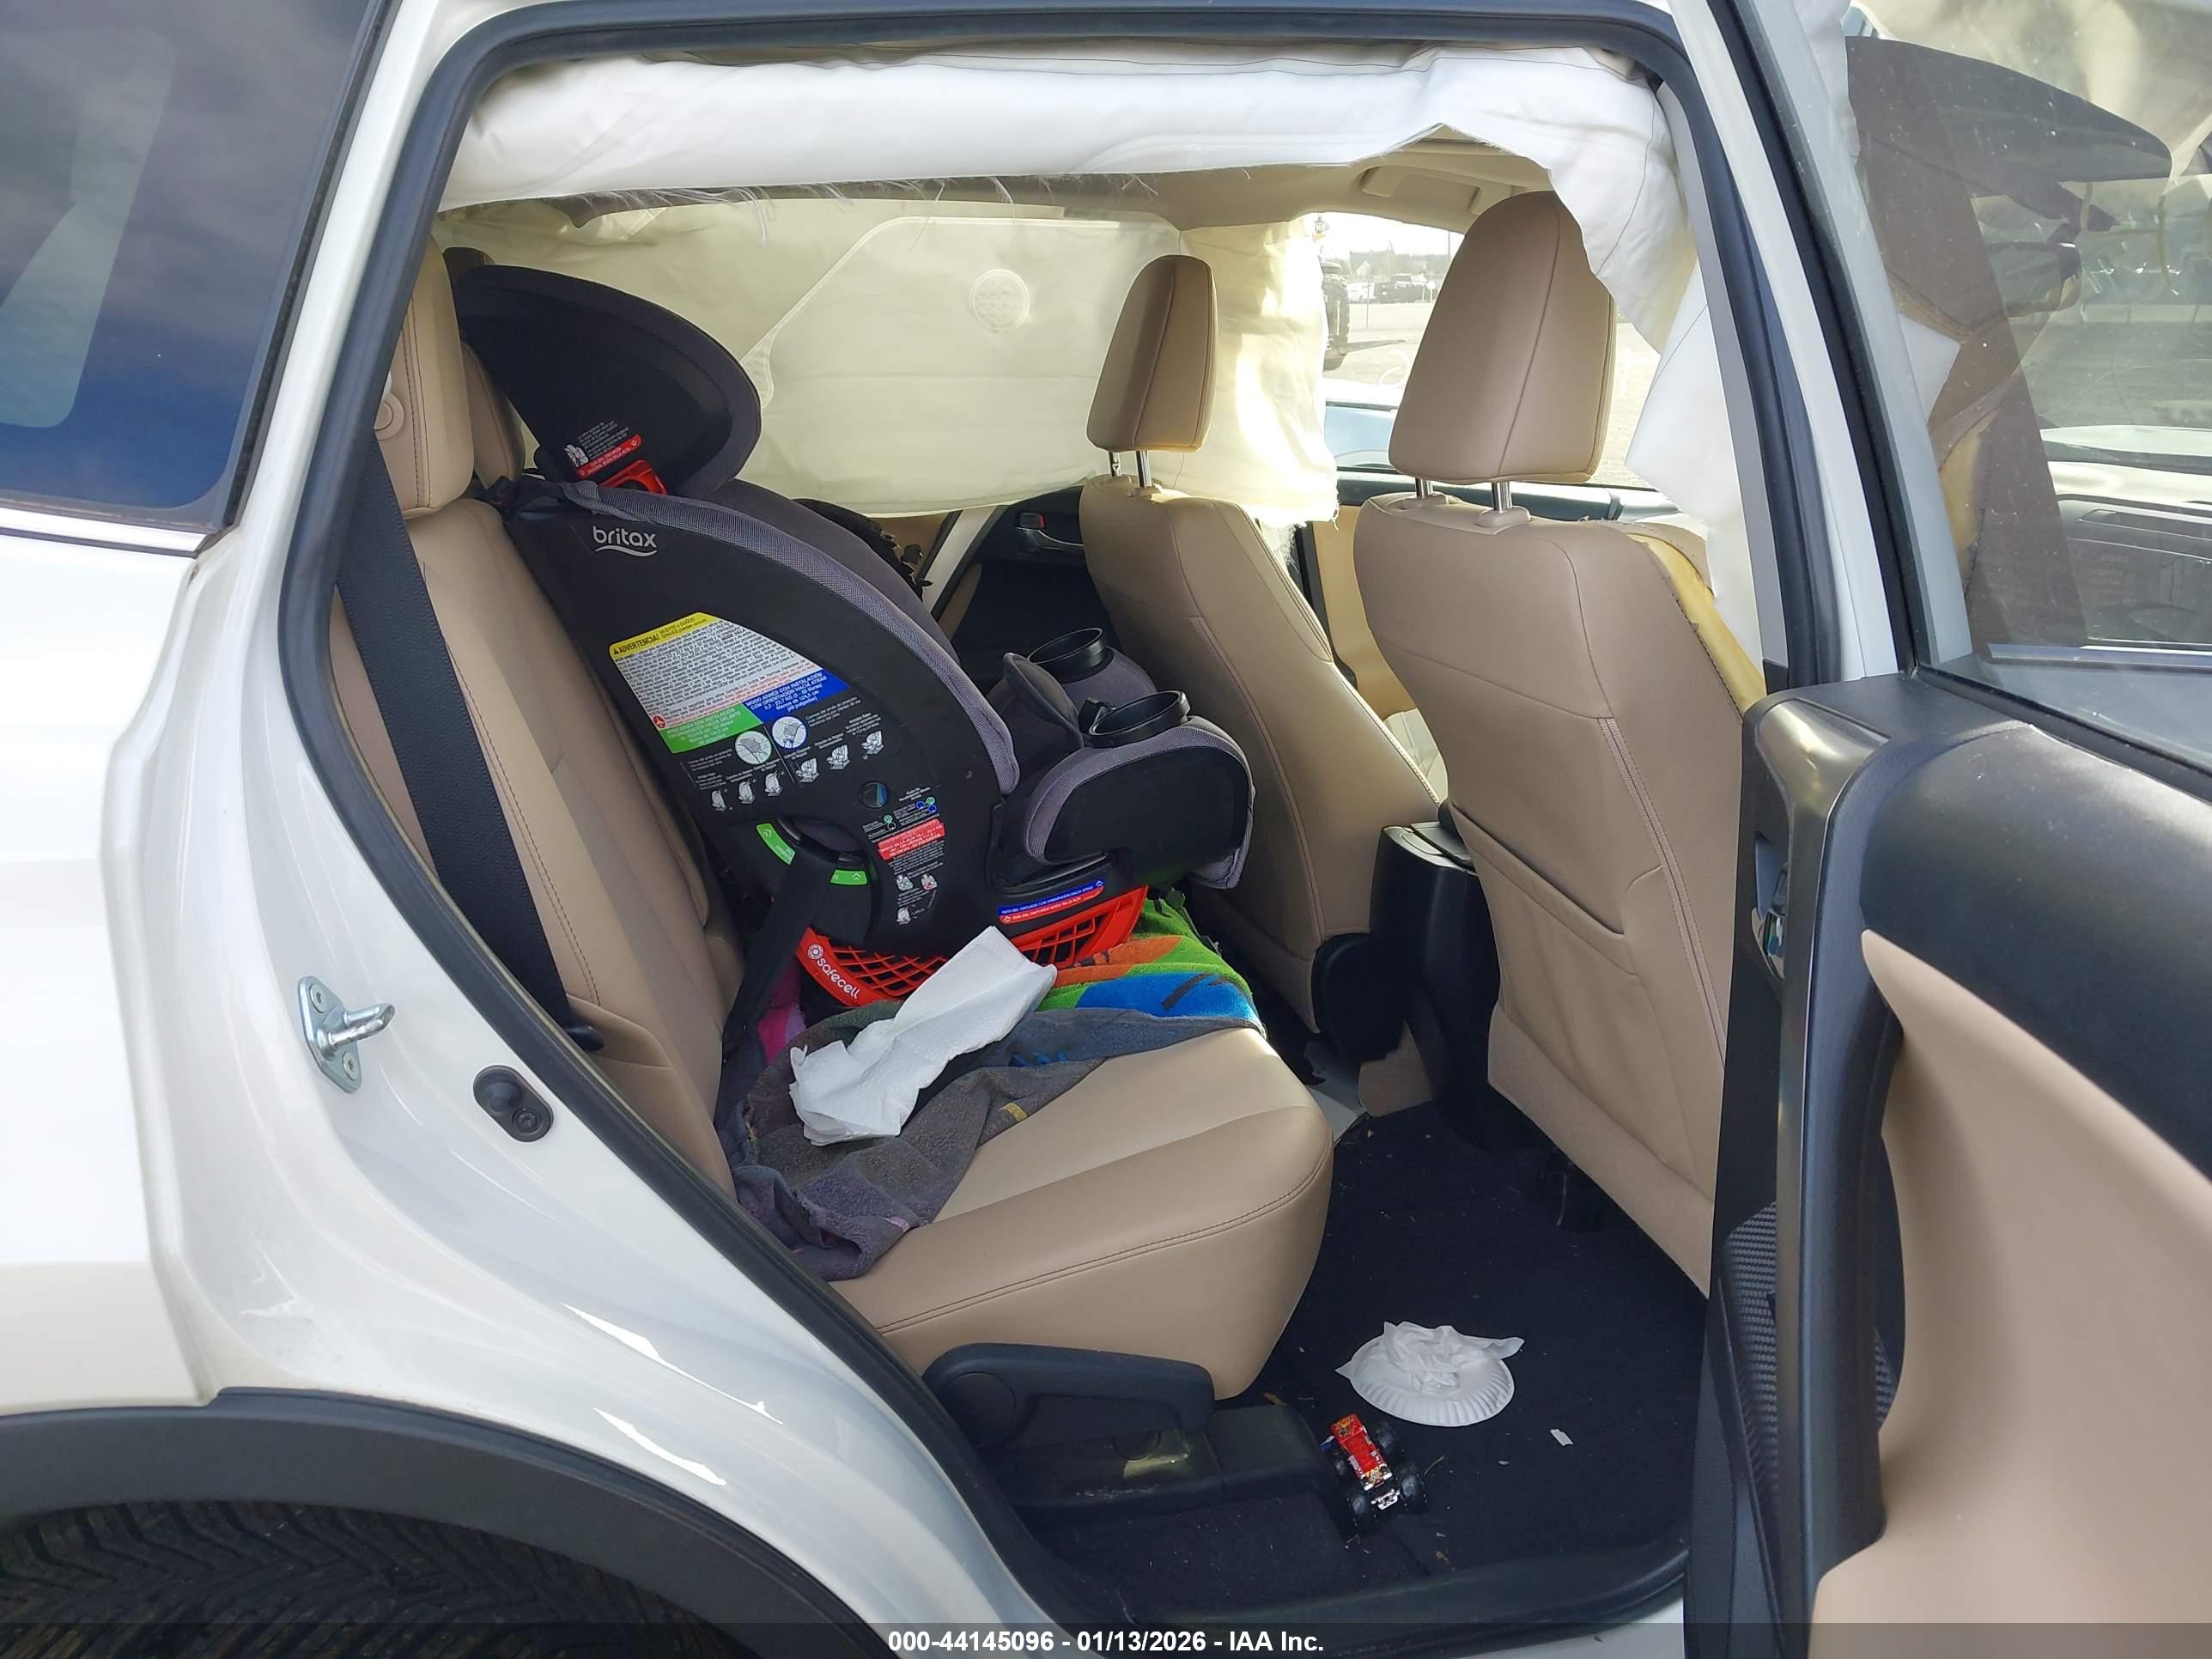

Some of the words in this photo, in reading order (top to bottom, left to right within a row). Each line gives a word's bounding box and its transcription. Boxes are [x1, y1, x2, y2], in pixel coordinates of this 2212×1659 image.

[592, 526, 657, 548] britax
[618, 634, 660, 653] ADVERTENCIA!
[817, 957, 861, 1000] safecell
